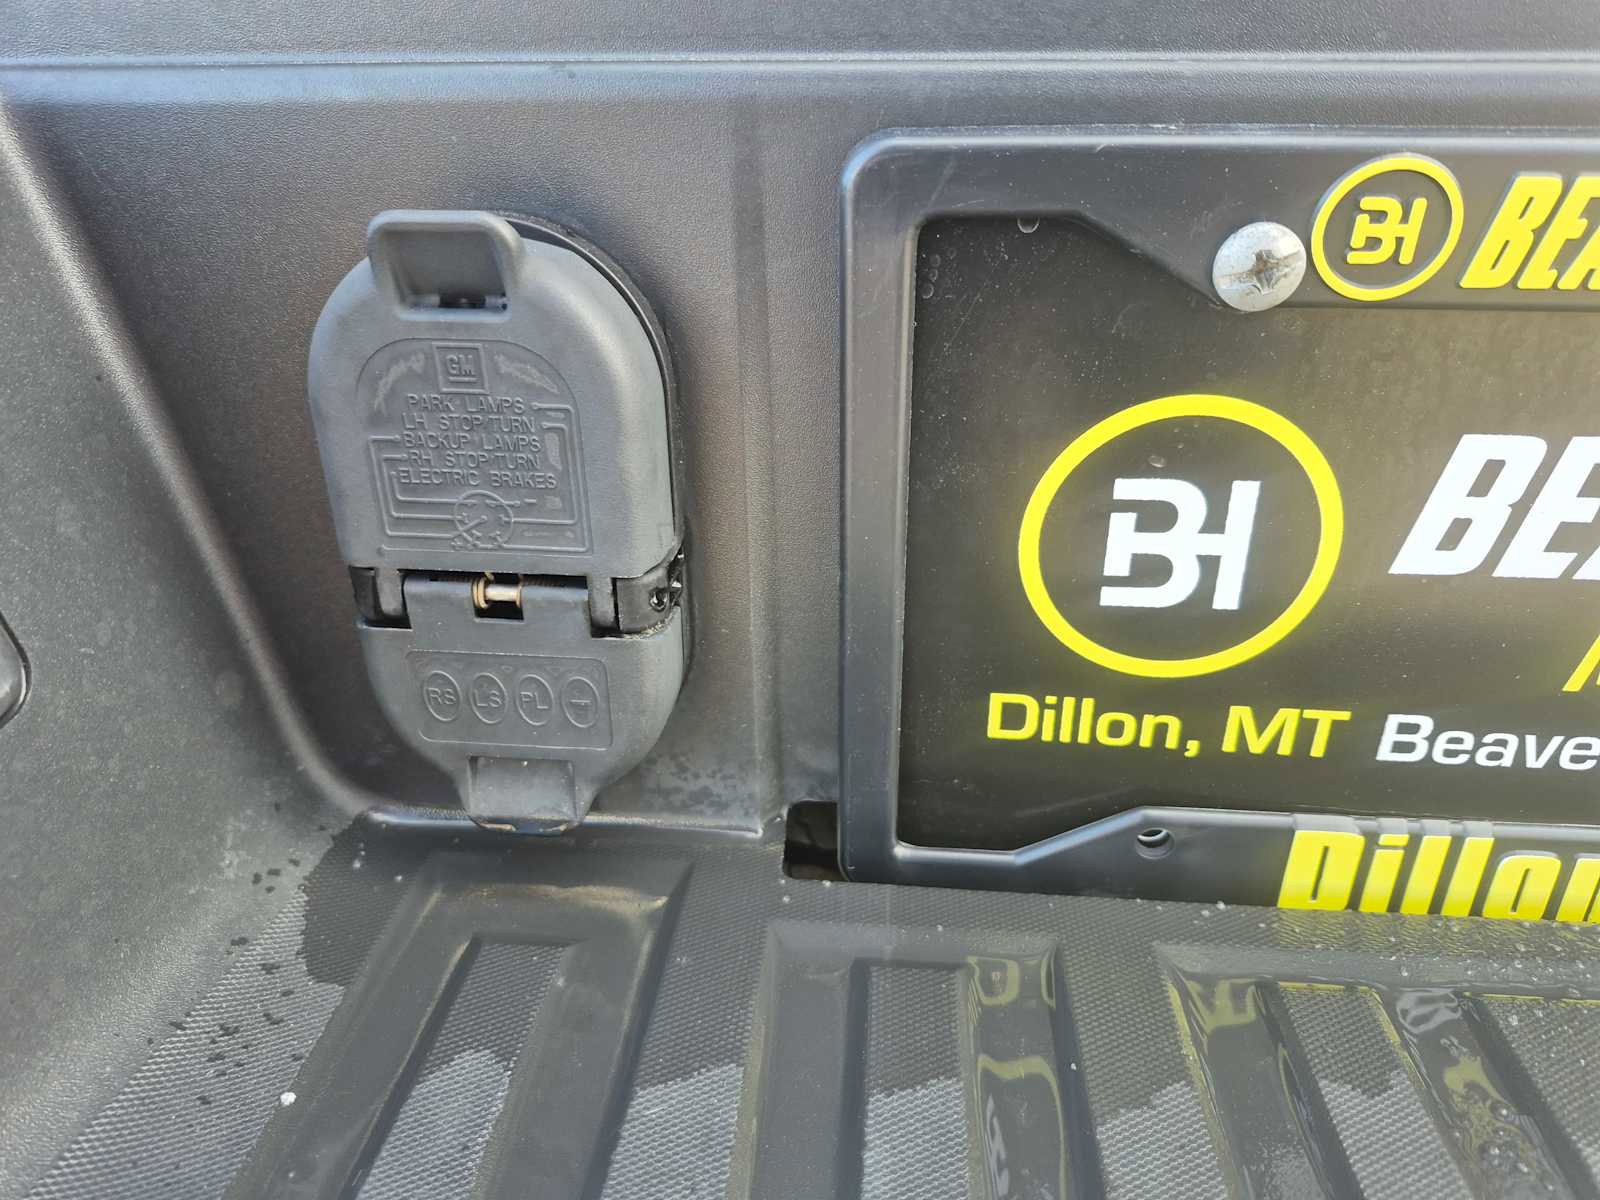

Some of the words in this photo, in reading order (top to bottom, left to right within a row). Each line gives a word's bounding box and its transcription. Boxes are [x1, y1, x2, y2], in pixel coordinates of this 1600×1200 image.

[446, 353, 475, 376] GM
[407, 393, 455, 412] PARK
[465, 395, 525, 415] LAMPS
[401, 412, 428, 431] LH
[402, 431, 471, 450] BACKUP
[481, 433, 542, 452] LAMPS
[409, 449, 434, 467] RH
[398, 467, 481, 487] ELECTRIC
[489, 470, 558, 489] BRAKES
[1387, 433, 1600, 581] BE
[428, 687, 457, 705] RS
[473, 688, 502, 708] LS
[520, 691, 549, 709] PL
[986, 691, 1201, 759] Dillon,
[1221, 704, 1352, 759] MT
